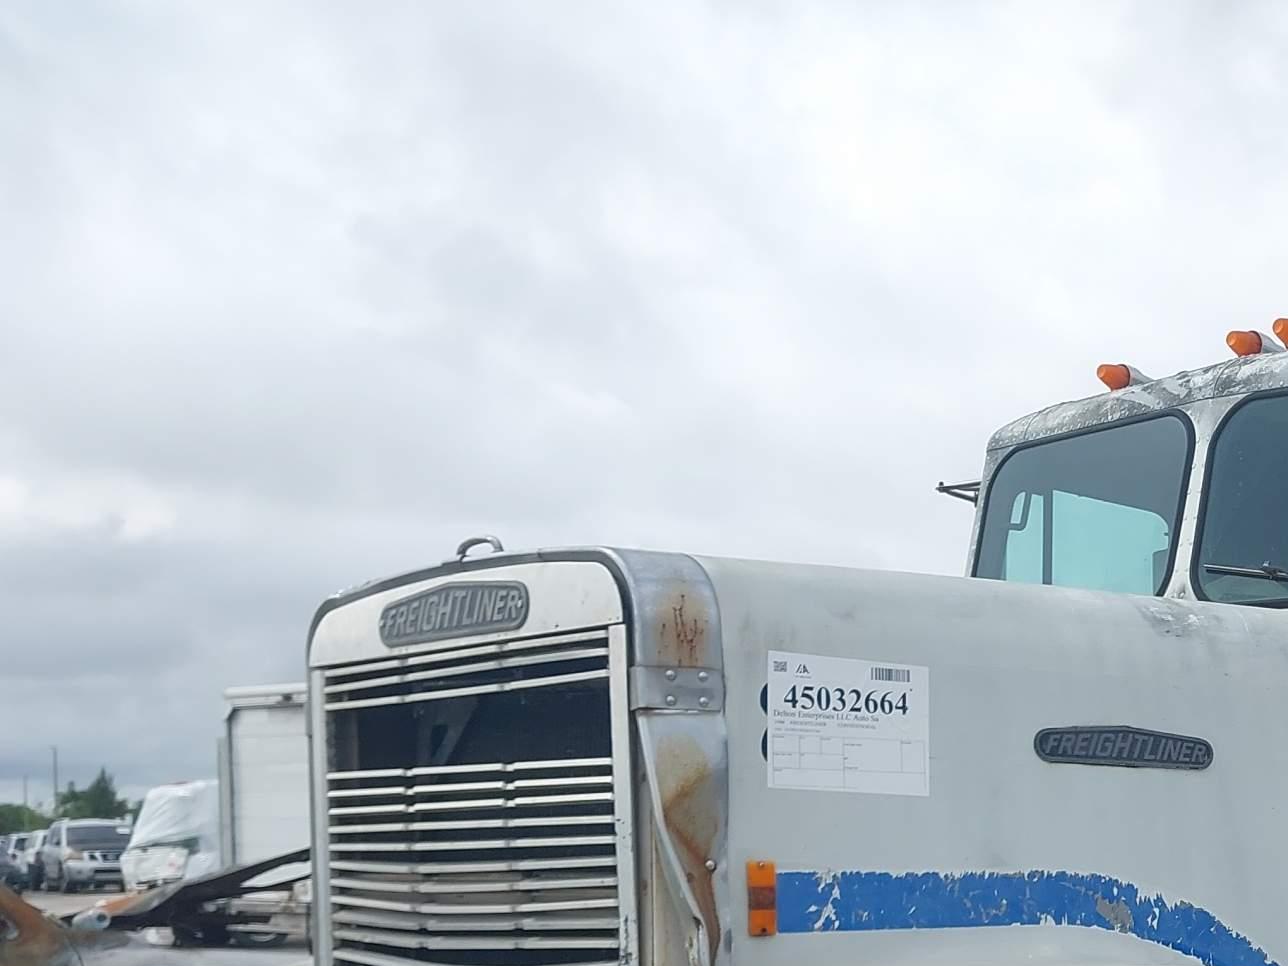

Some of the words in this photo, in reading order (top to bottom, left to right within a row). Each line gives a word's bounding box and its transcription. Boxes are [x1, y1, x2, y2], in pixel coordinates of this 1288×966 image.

[384, 589, 520, 637] FREIGHTLINER
[784, 684, 909, 716] 45032664
[1044, 732, 1208, 763] FREIGHTLINER
